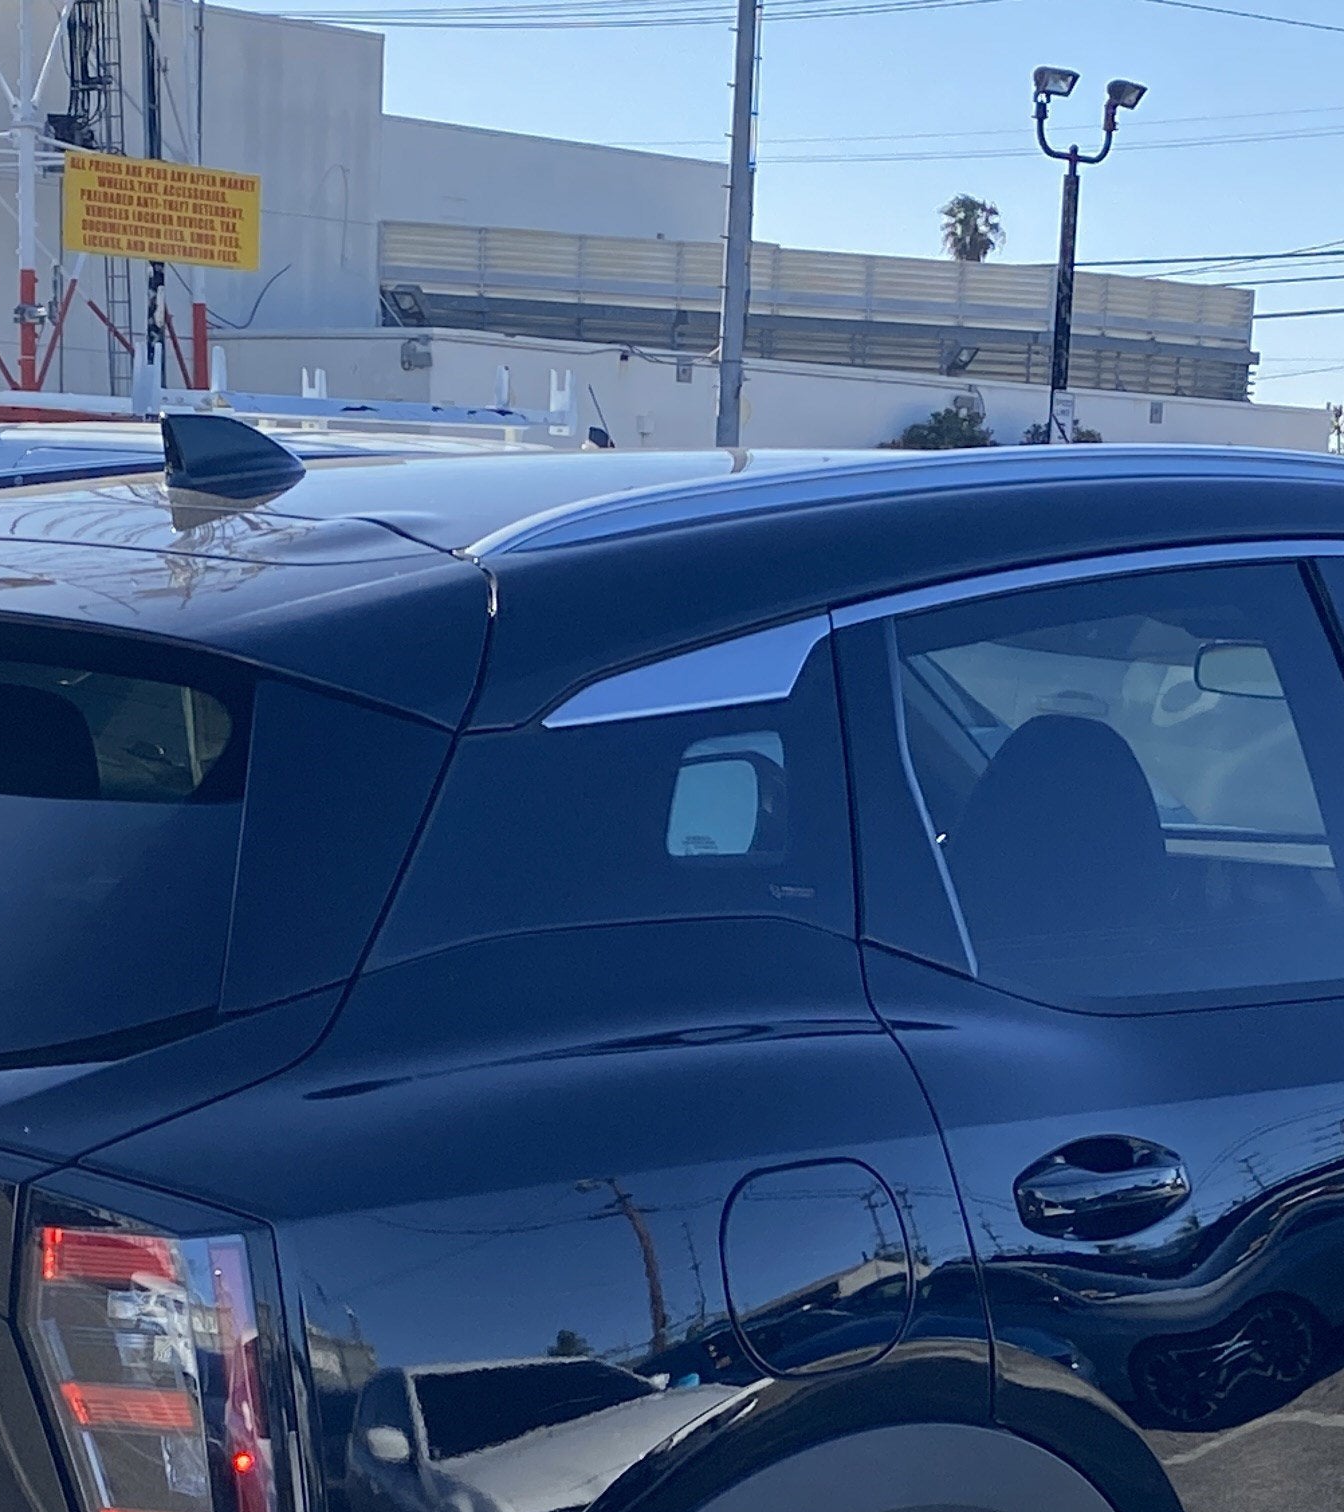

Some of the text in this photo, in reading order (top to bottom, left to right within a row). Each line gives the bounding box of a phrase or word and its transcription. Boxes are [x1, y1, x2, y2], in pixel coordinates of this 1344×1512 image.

[70, 156, 255, 193] ALL PRICES ARE PLUS ANY AFTER MARKET
[80, 188, 134, 206] PRELOADED
[137, 195, 189, 214] ANTI-THEFT
[85, 204, 130, 221] VEHICLES
[132, 209, 173, 226] LOCATOR
[81, 218, 162, 240] DOCUMENTATION
[126, 238, 146, 253] AND
[149, 241, 215, 261] REGISTRATION
